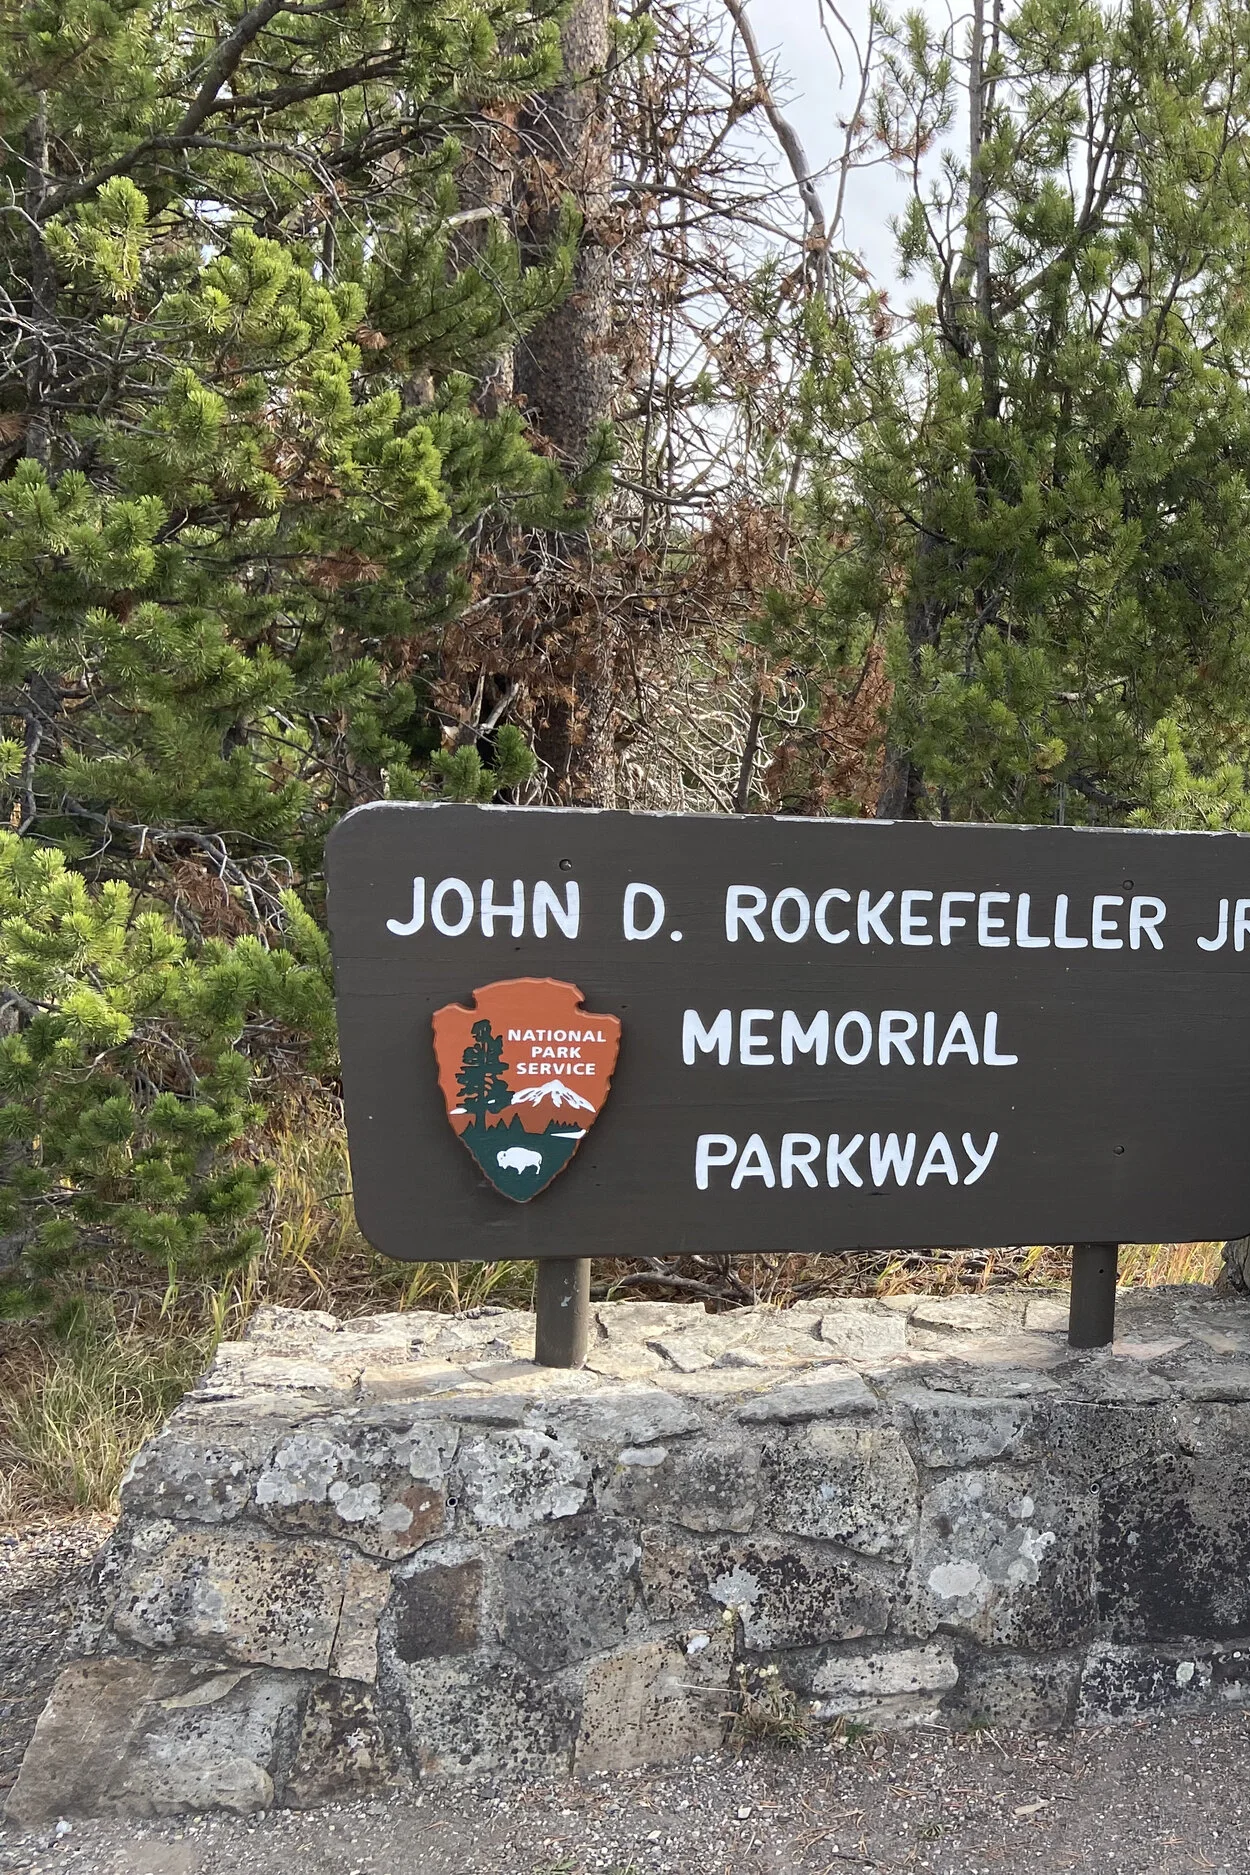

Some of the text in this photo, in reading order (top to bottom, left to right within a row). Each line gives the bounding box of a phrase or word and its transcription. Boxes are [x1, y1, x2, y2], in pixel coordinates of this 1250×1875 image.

[386, 877, 580, 940] JOHN
[624, 883, 683, 942] D.
[726, 885, 1167, 950] ROCKEFELLER
[508, 1030, 606, 1043] NATIONAL
[531, 1046, 581, 1059] PARK
[683, 1009, 1018, 1066] MEMORIAL
[516, 1063, 596, 1075] SERVICE
[696, 1132, 999, 1190] PARKWAY
